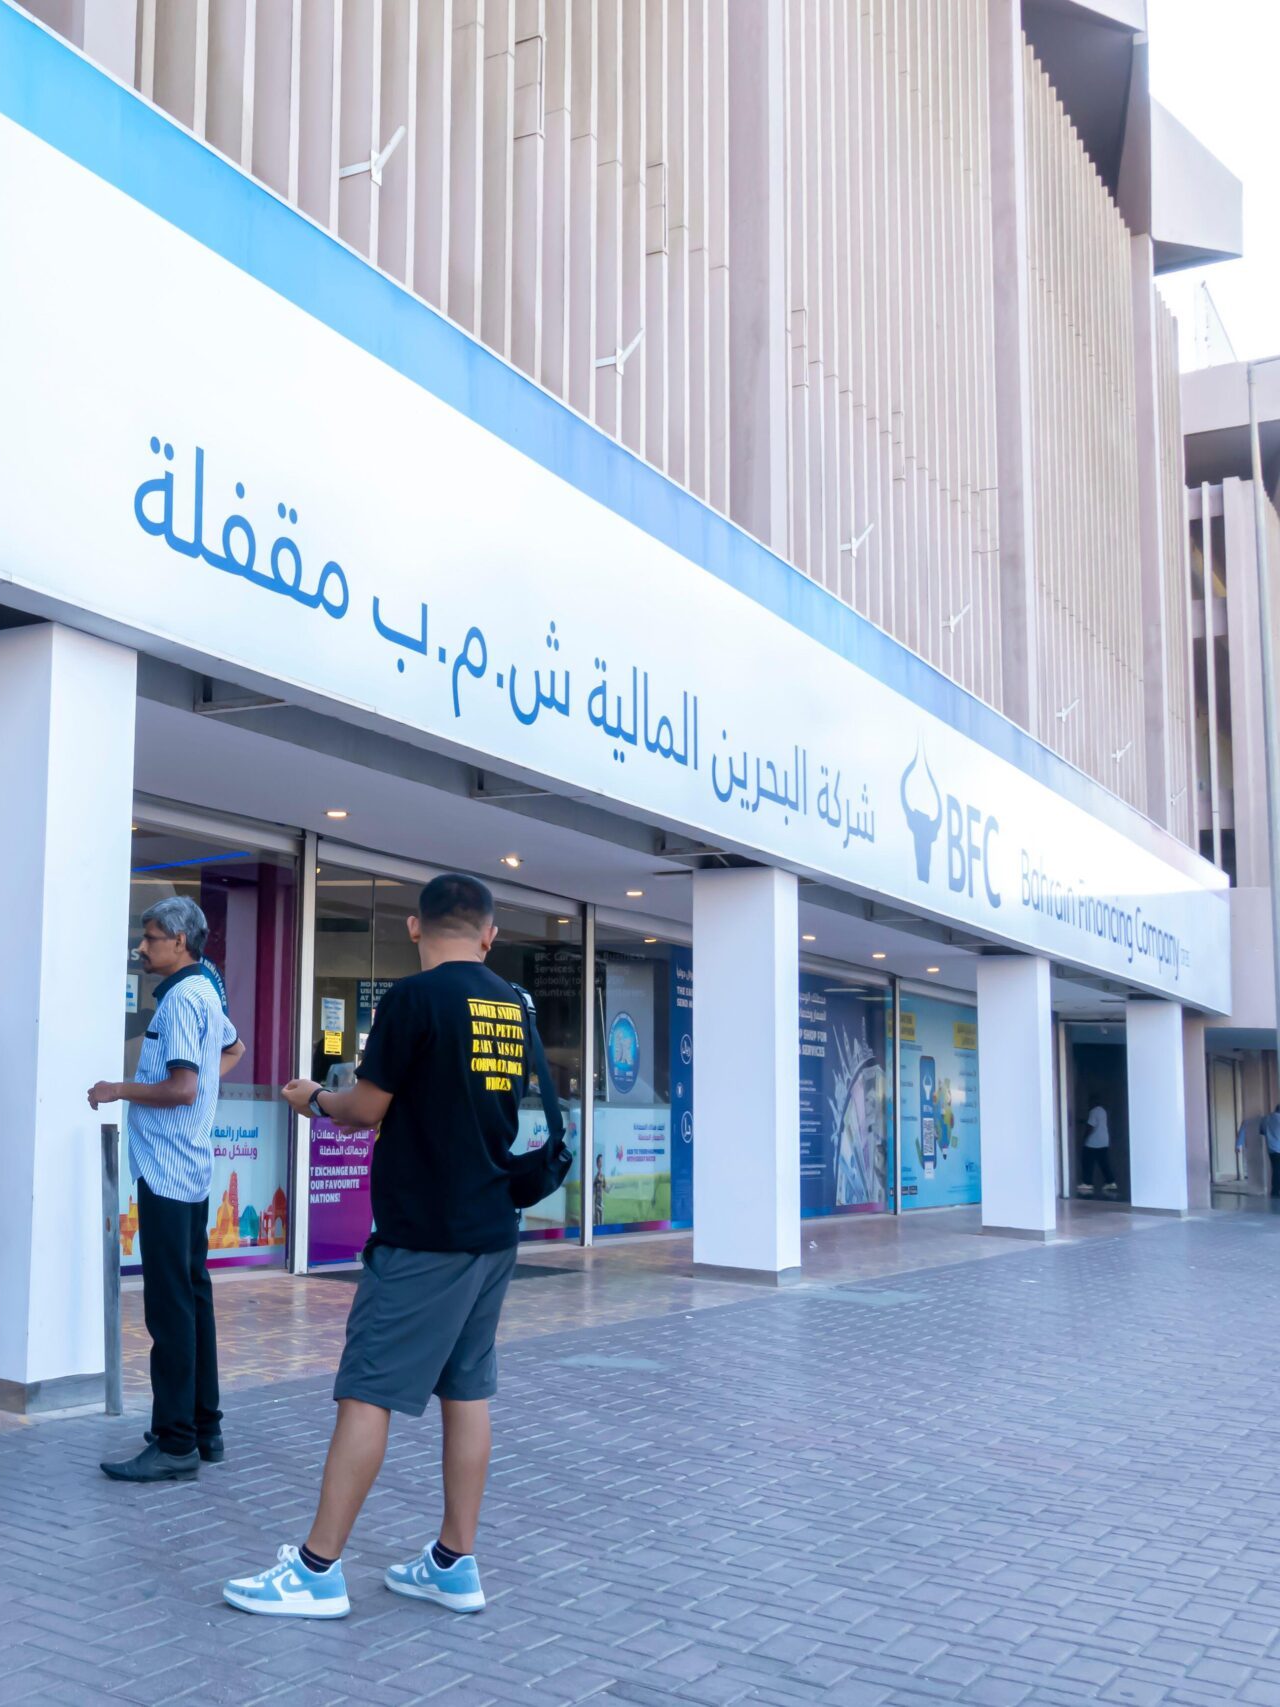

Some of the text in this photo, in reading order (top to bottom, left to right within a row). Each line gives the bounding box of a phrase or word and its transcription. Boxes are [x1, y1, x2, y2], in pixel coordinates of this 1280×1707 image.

[134, 435, 349, 620] مقفلة
[587, 657, 698, 770] المالية
[712, 729, 807, 825] البحرين
[817, 764, 875, 849] شركة
[946, 793, 1001, 909] BFC
[1021, 849, 1180, 981] Bahrain Financing Company
[314, 1166, 348, 1177] EXCHANGE
[348, 1165, 368, 1176] RATES
[325, 1178, 360, 1189] FAVOURITE
